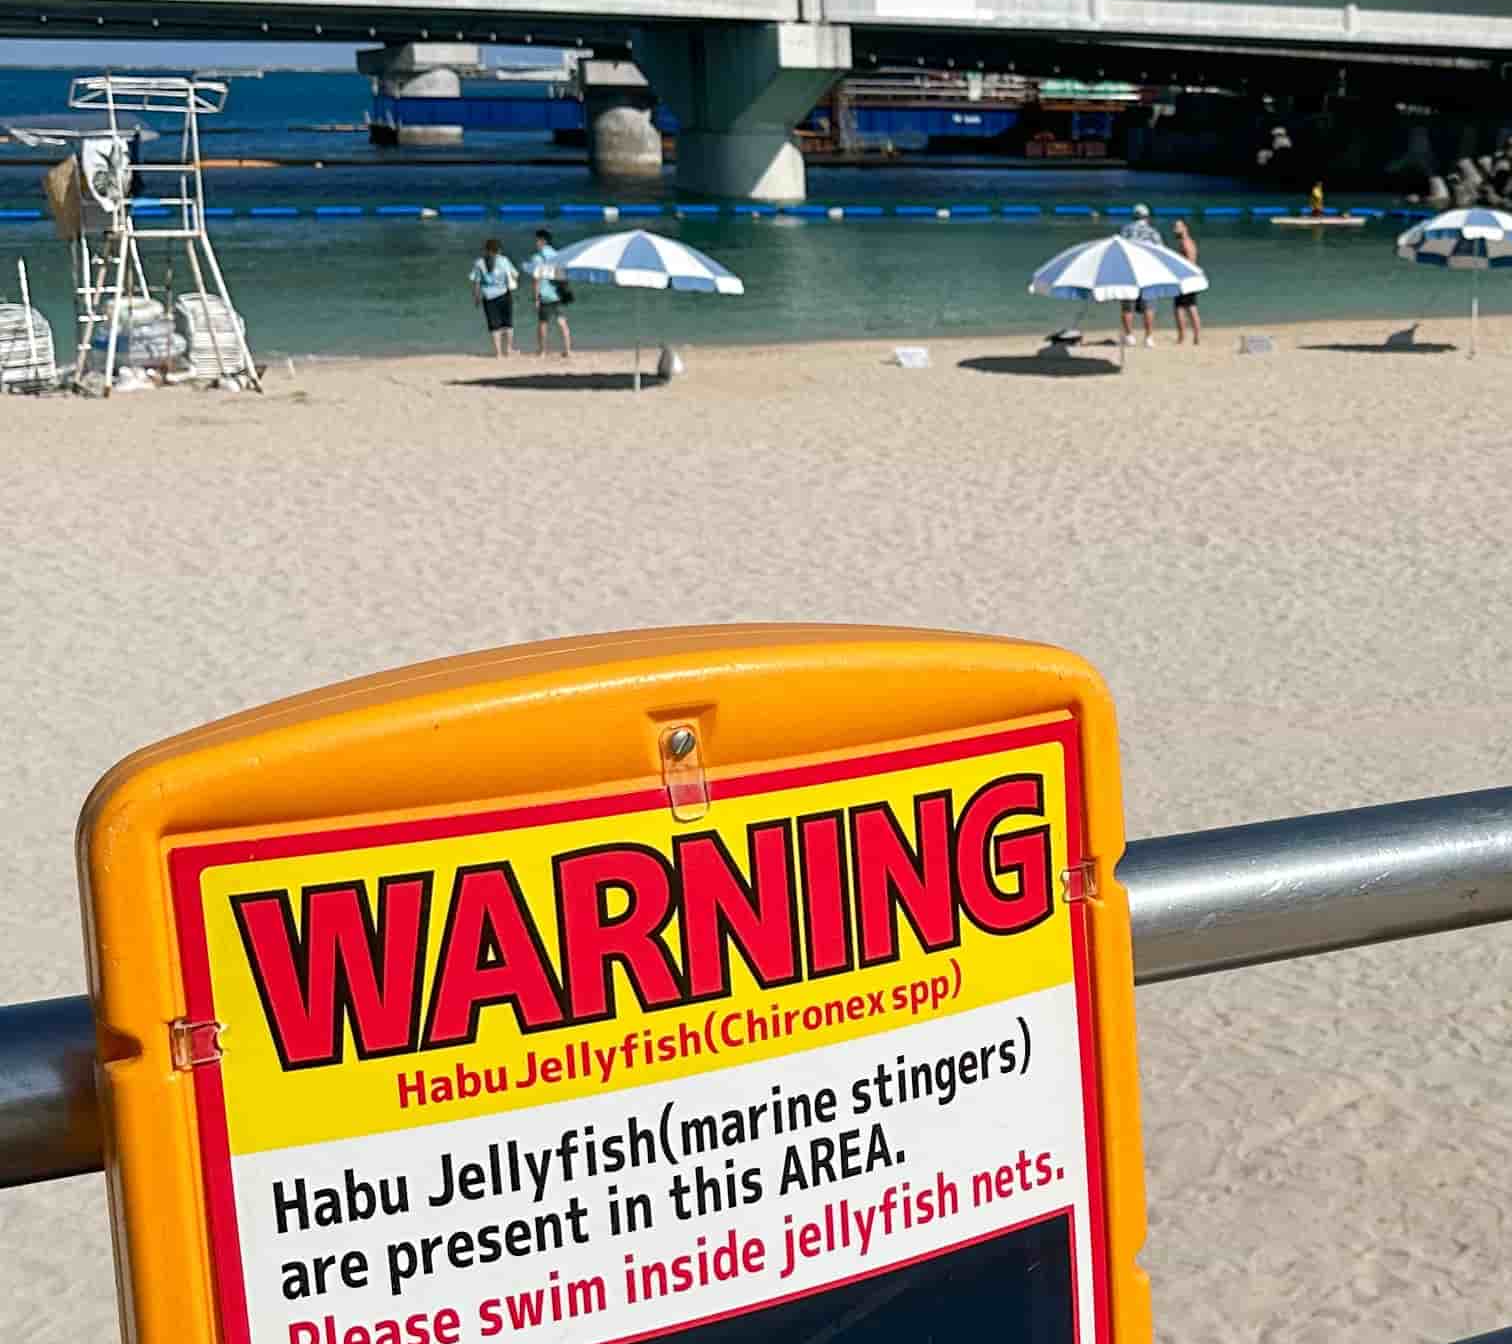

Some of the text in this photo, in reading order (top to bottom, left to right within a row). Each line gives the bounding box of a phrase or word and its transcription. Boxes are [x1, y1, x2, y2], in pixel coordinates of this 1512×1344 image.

[230, 773, 1054, 1072] WARNING
[273, 1165, 409, 1234] Habu
[850, 1016, 1032, 1120] stingers)
[280, 1126, 907, 1300] are present in this AREA.
[477, 1275, 607, 1333] swim
[624, 1246, 766, 1311] inside
[780, 1193, 958, 1278] jellyfish
[971, 1143, 1066, 1201] nets.
